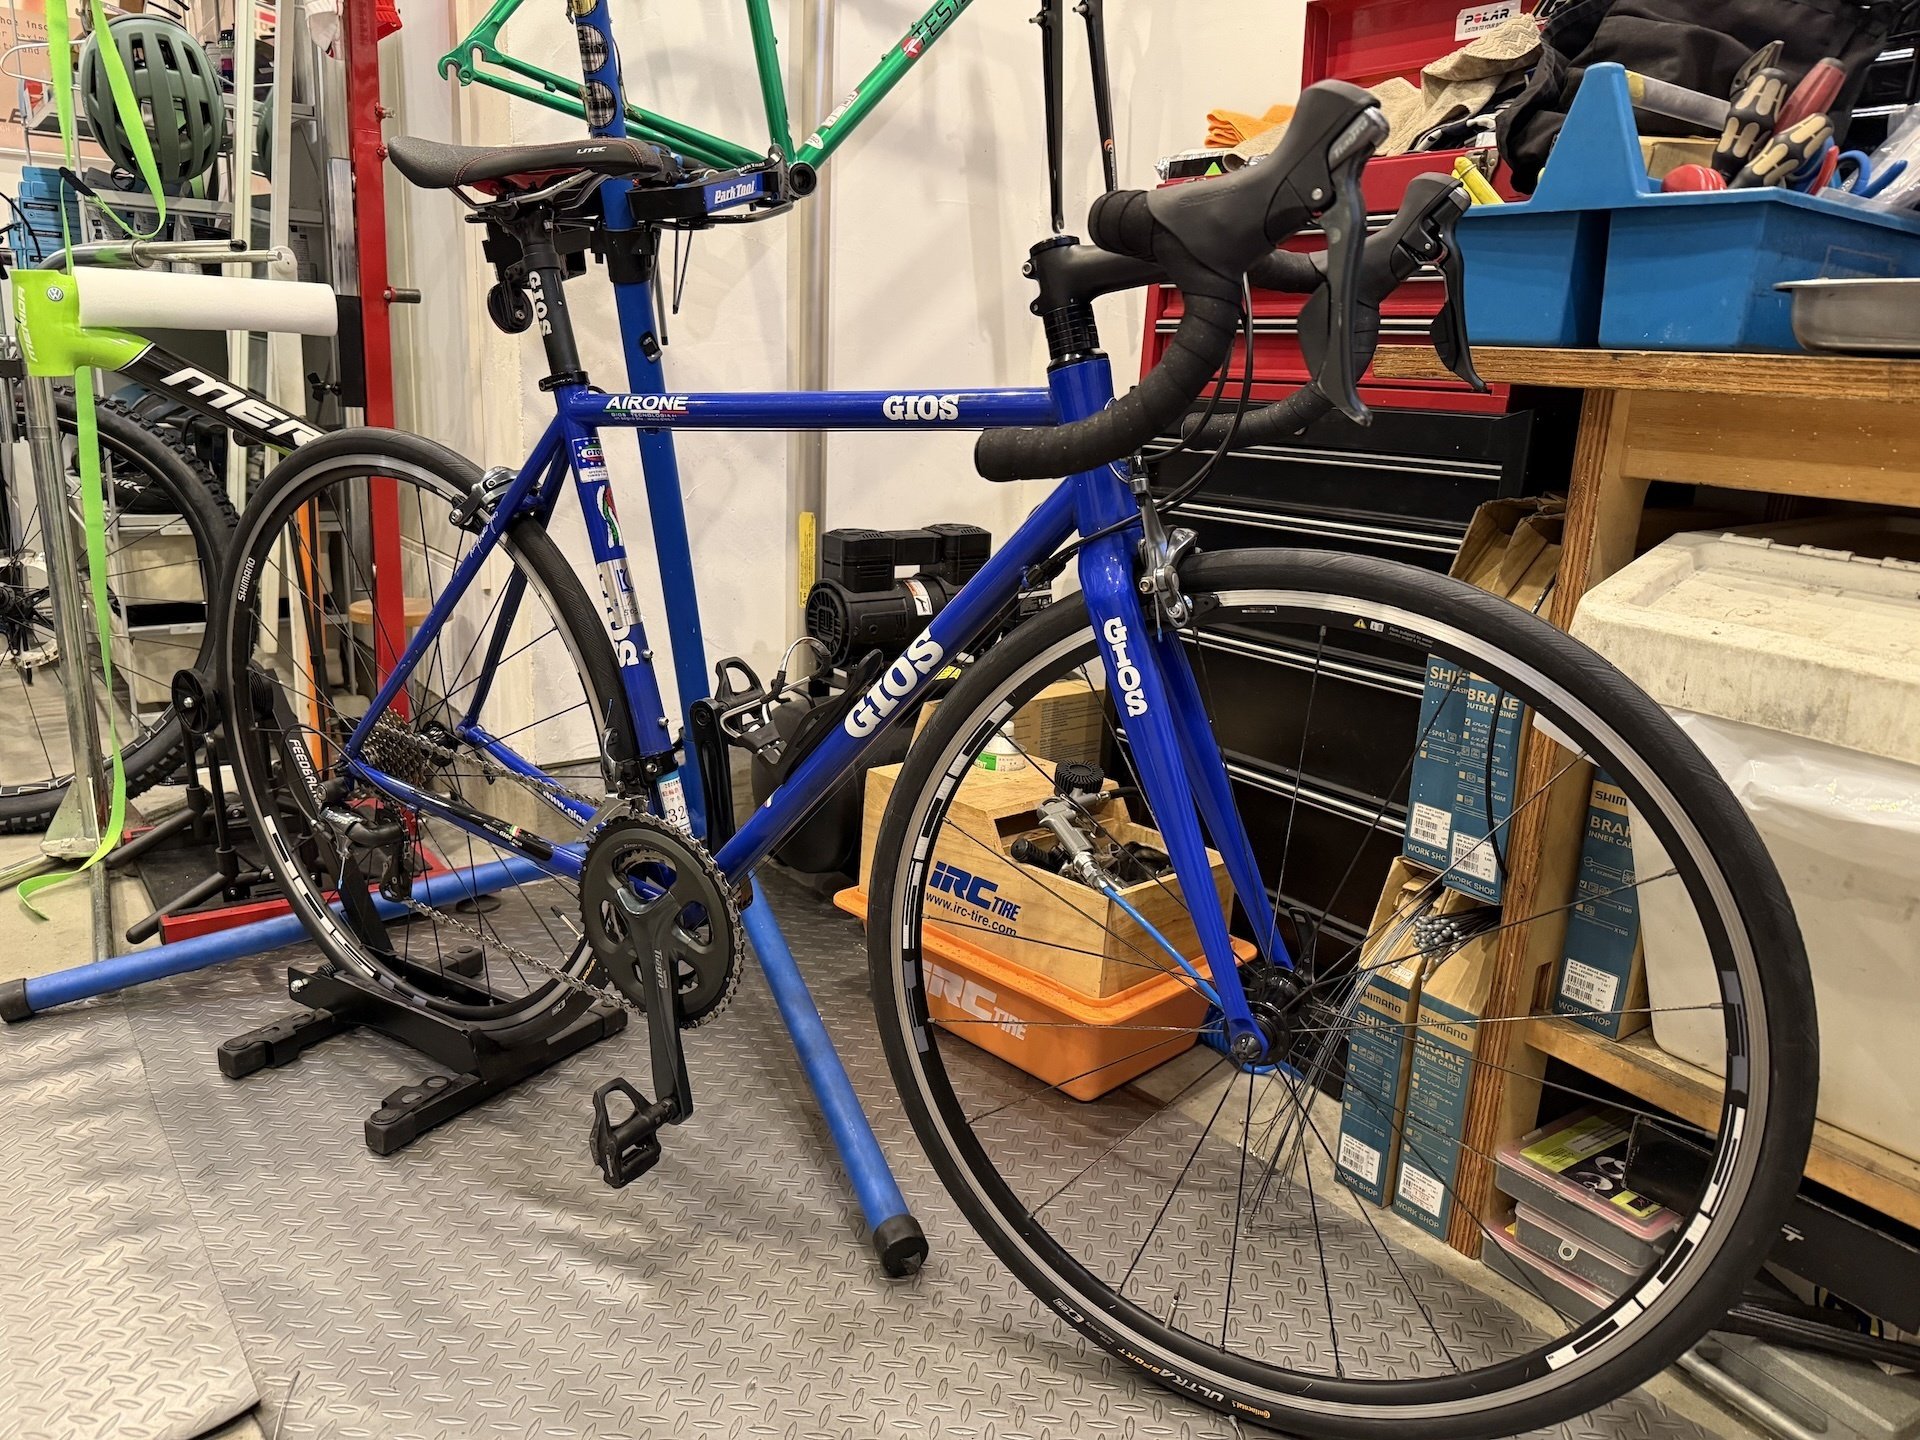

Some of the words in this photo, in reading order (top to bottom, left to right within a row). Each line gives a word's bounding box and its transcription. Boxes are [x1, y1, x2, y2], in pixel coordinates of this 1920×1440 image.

[1464, 8, 1510, 26] POLAR
[529, 270, 553, 337] GIOS
[606, 396, 689, 411] AIRONE
[882, 395, 960, 422] GIOS
[237, 556, 256, 603] SHIMANO
[1102, 617, 1149, 718] GIOS
[1429, 666, 1466, 685] SHIF
[844, 628, 945, 740] GIOS
[1594, 789, 1628, 808] SHIM
[668, 805, 686, 823] 32
[1588, 829, 1614, 844] INNER
[1407, 842, 1430, 857] WORK
[1448, 873, 1473, 888] WORK
[1473, 882, 1496, 896] SHOP
[925, 891, 1017, 938] www.irc-tire.com
[991, 896, 1022, 923] TIRE
[653, 949, 665, 990] Tiagra
[1362, 990, 1402, 1014] HIMANO
[991, 1008, 1030, 1042] TIRE
[1420, 1014, 1469, 1042] SHIMANO
[1588, 1010, 1612, 1028] SHOP
[1375, 1030, 1398, 1047] CABLE
[1415, 1035, 1466, 1068] BRAKE
[1415, 1046, 1438, 1063] INNER
[1438, 1058, 1463, 1076] CABLE
[1358, 1182, 1379, 1198] SHOP
[1395, 1199, 1418, 1217] WORK
[1418, 1213, 1441, 1229] SHOP
[1230, 1399, 1271, 1420] Continental
